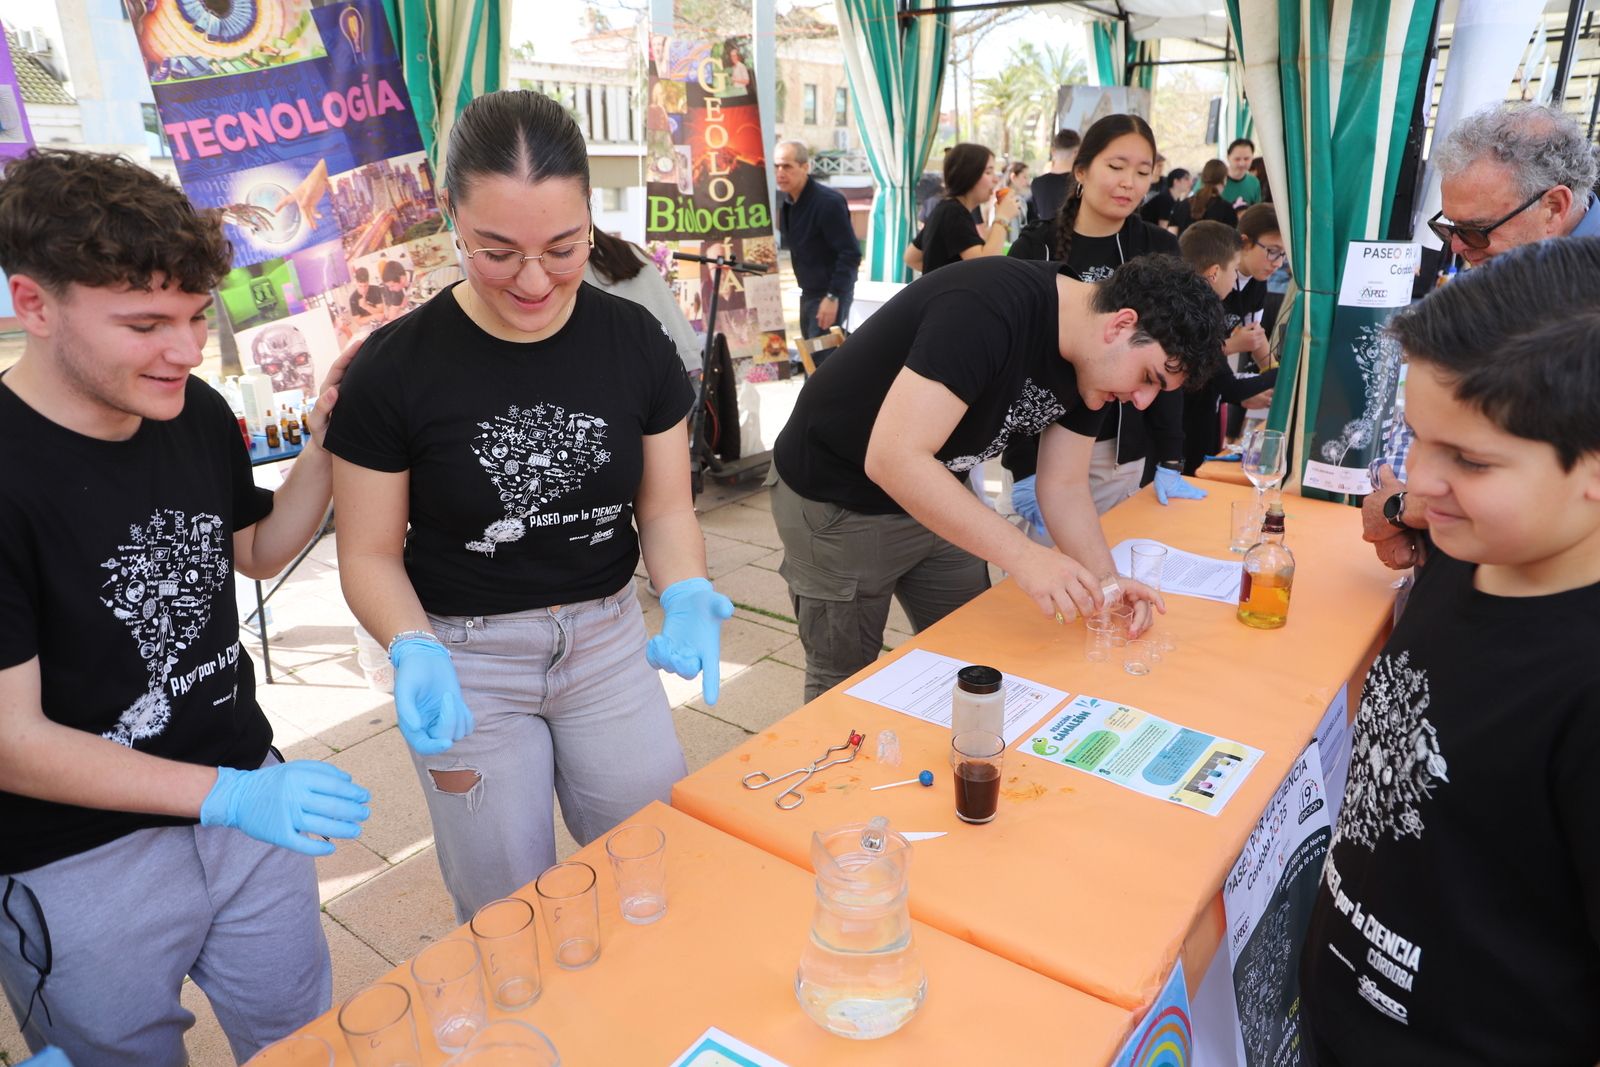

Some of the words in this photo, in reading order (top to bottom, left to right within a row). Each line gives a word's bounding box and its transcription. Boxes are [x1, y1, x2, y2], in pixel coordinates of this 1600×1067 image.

[165, 74, 405, 161] TECNOLOGÍA
[1363, 247, 1402, 259] PASEO
[530, 512, 560, 528] PASEO
[562, 514, 579, 525] por
[581, 509, 589, 520] la
[591, 503, 622, 519] CIENCIA
[198, 660, 216, 682] por
[217, 653, 226, 670] la
[1052, 711, 1092, 742] CAMALEÓN
[1277, 759, 1308, 805] CIENCIA
[1247, 838, 1271, 890] Córdoba
[1270, 803, 1288, 841] 2025
[1309, 833, 1327, 848] Norte
[1334, 889, 1354, 916] por
[1351, 902, 1366, 931] la
[1363, 914, 1421, 972] CIENCIA
[1366, 947, 1414, 992] CÓRDOBA
